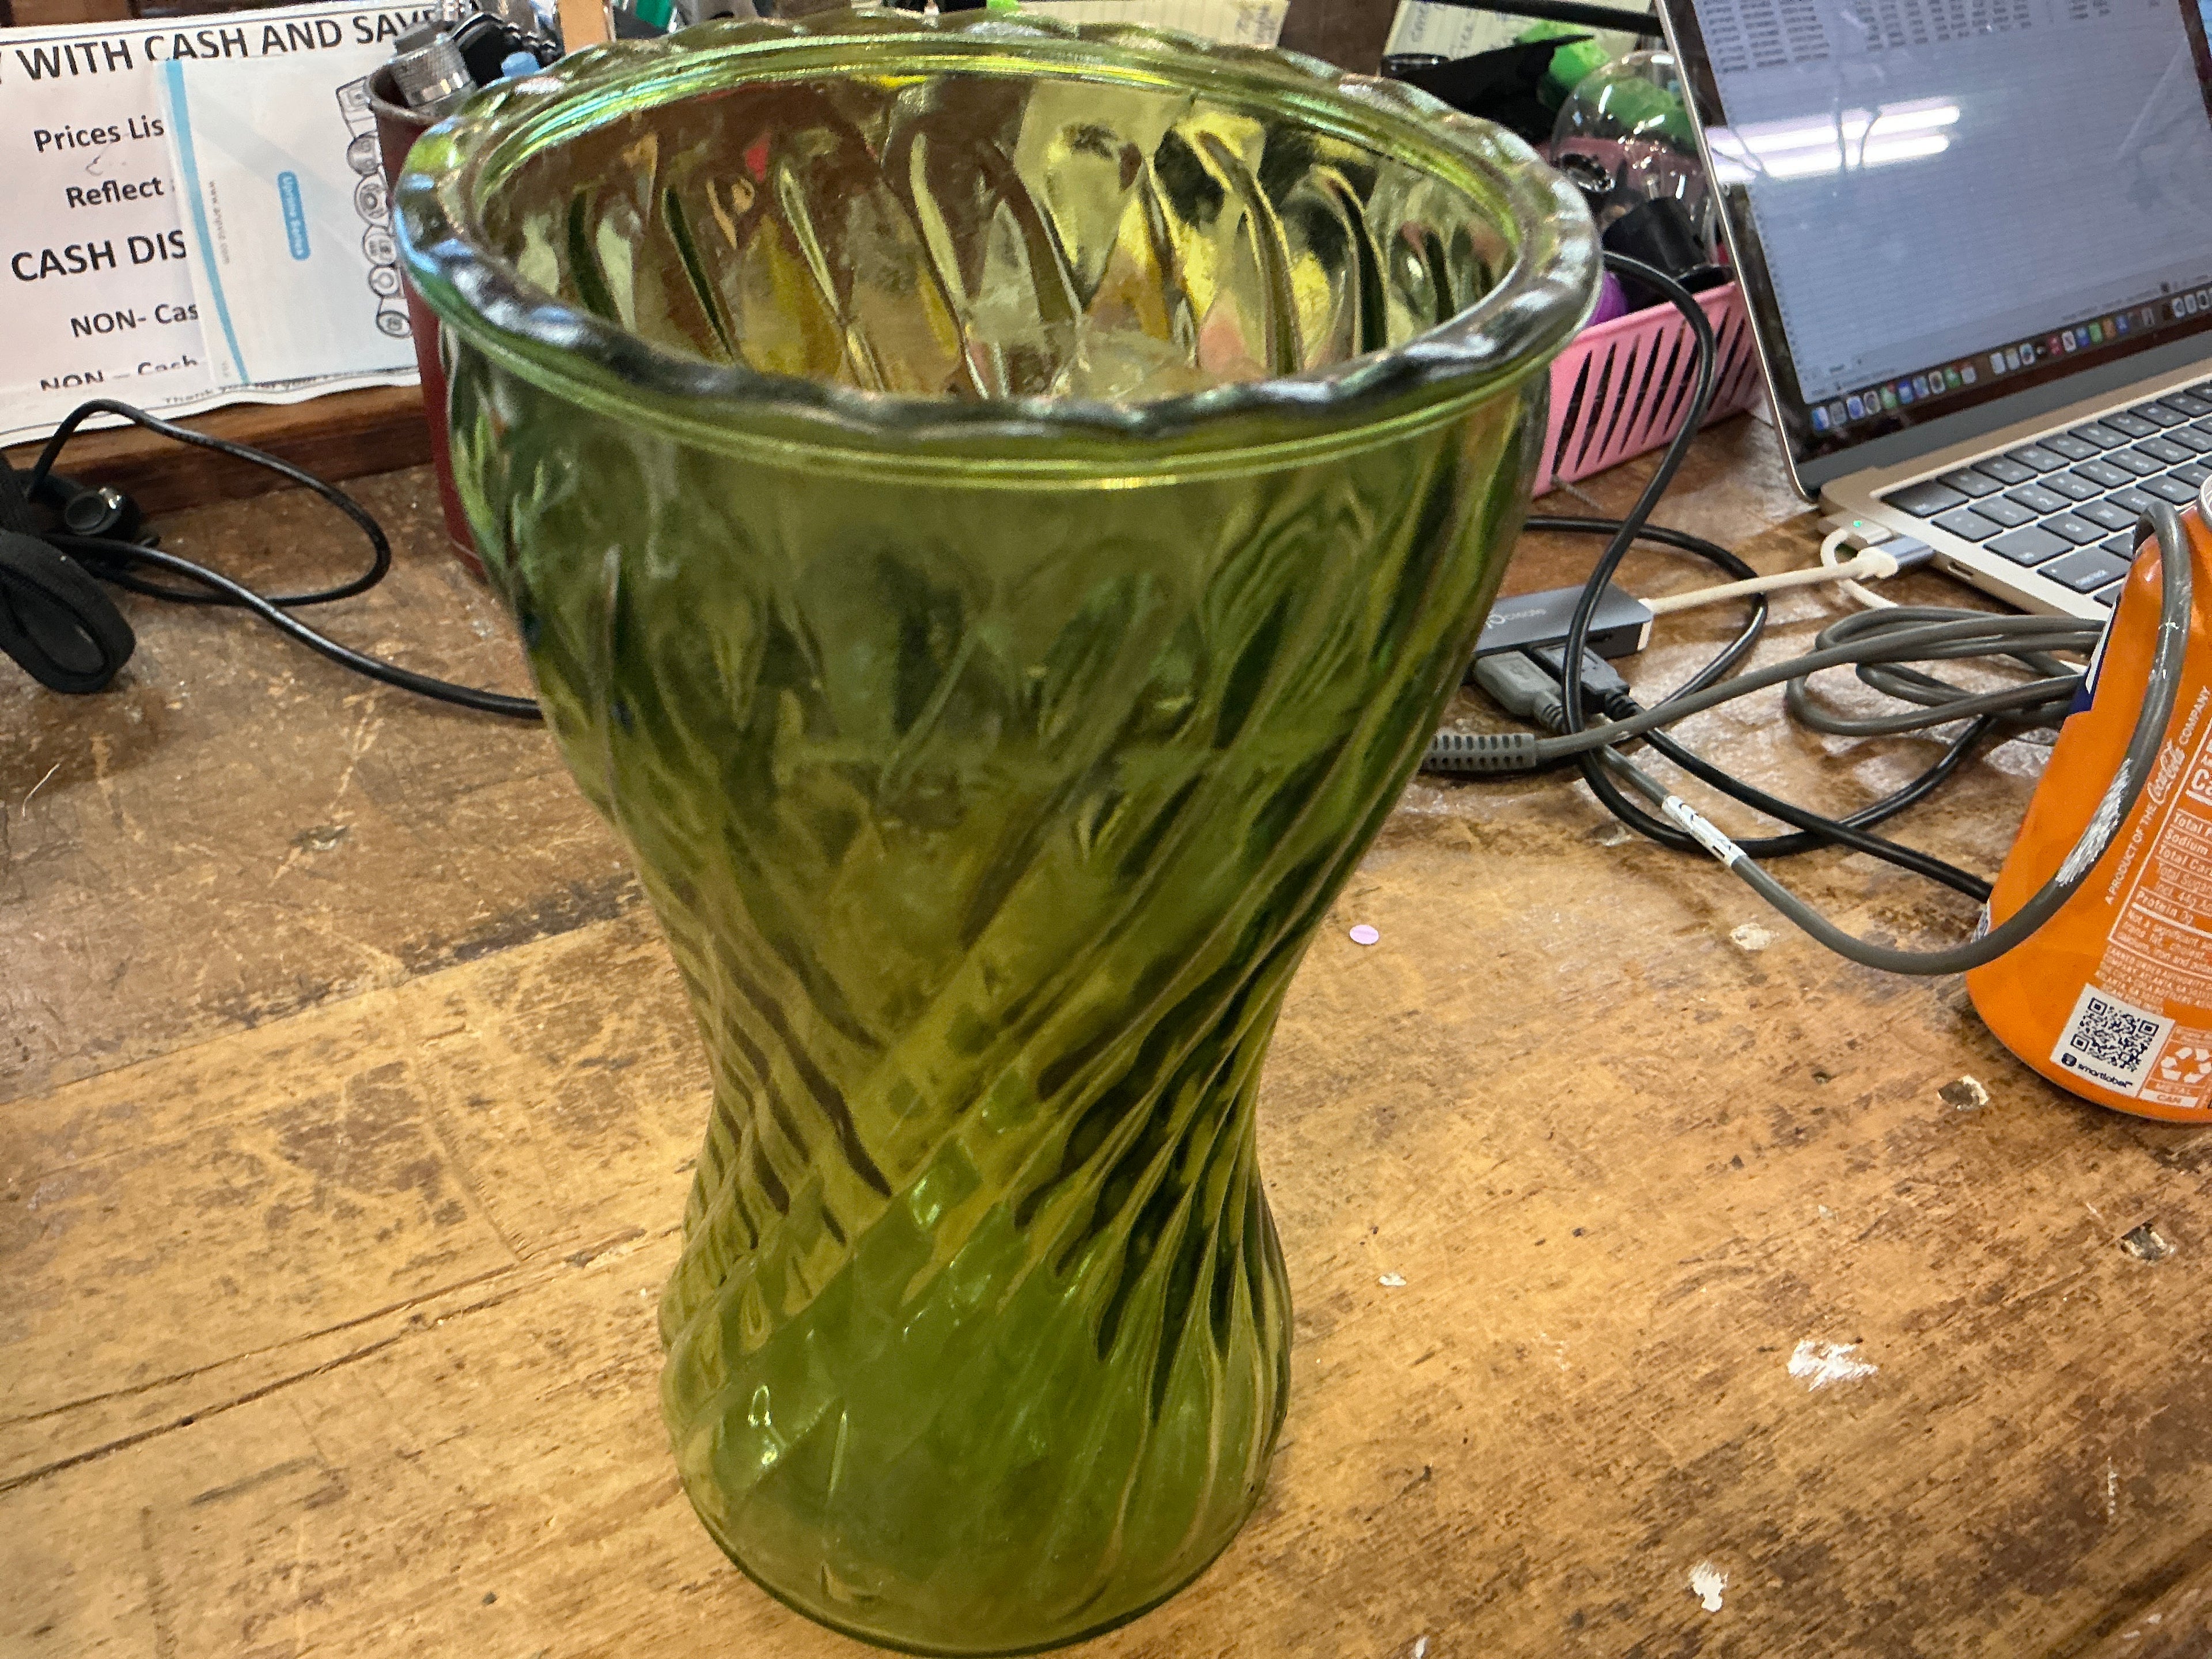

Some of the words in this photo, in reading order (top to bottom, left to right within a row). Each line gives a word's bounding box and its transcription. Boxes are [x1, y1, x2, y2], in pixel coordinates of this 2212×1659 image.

[16, 39, 132, 80] WITH
[145, 28, 248, 62] CASH
[262, 20, 342, 55] AND
[33, 124, 121, 153] Prices
[66, 176, 165, 208] Reflect
[11, 239, 117, 281] CASH
[127, 229, 187, 265] DIS
[2108, 842, 2138, 895] PRODUCT
[2132, 825, 2145, 843] OF
[2139, 802, 2158, 825] THE
[2179, 685, 2211, 745] COMPANY
[2174, 812, 2203, 835] Total
[2158, 843, 2188, 865] Total
[2164, 828, 2209, 855] Sodium
[2136, 891, 2178, 917] Protein
